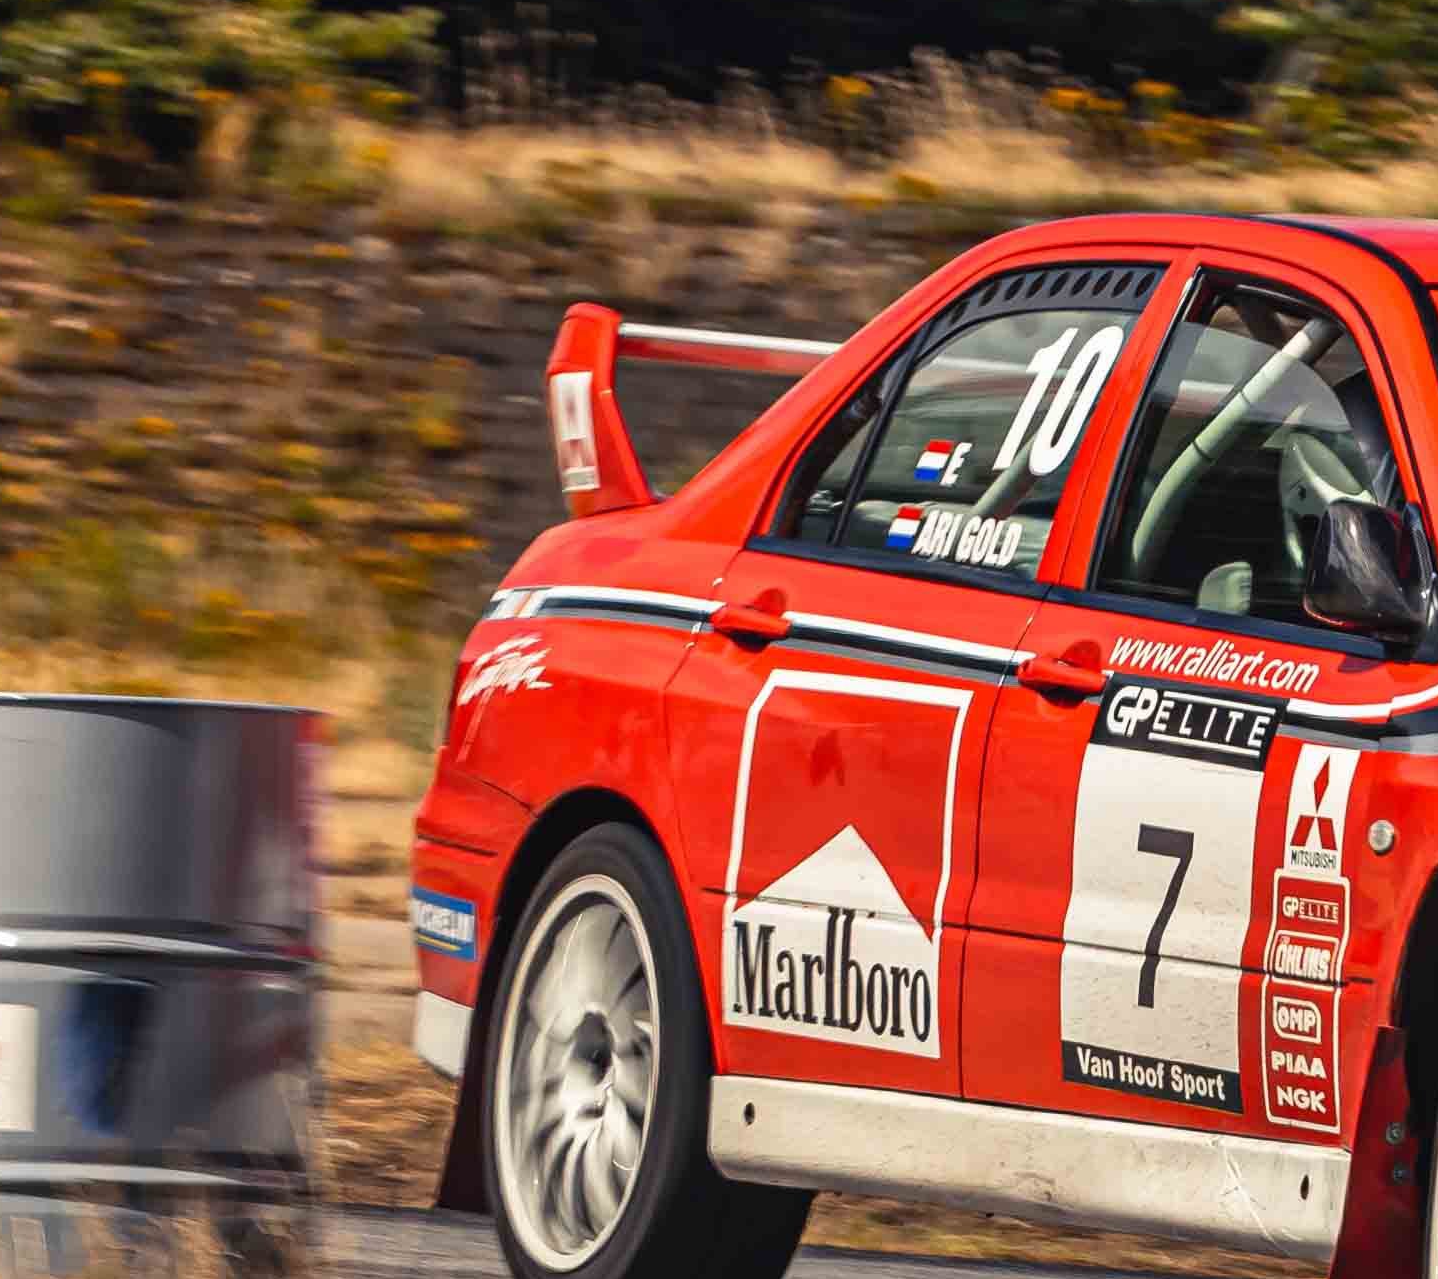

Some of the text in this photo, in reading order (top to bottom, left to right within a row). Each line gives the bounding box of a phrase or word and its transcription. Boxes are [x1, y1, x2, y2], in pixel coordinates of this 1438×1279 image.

[992, 325, 1125, 476] 10
[911, 509, 1023, 568] ARI GOLD
[1108, 636, 1320, 693] www.ralliart.com
[1290, 849, 1337, 870] MITSUBISHI
[1137, 823, 1194, 1009] 7
[732, 905, 932, 1043] Marlboro
[1277, 1005, 1316, 1034] OMP
[1075, 1045, 1226, 1101] Van Hoof Sport
[1271, 1050, 1327, 1079] PIAA
[1276, 1085, 1327, 1115] NGK
